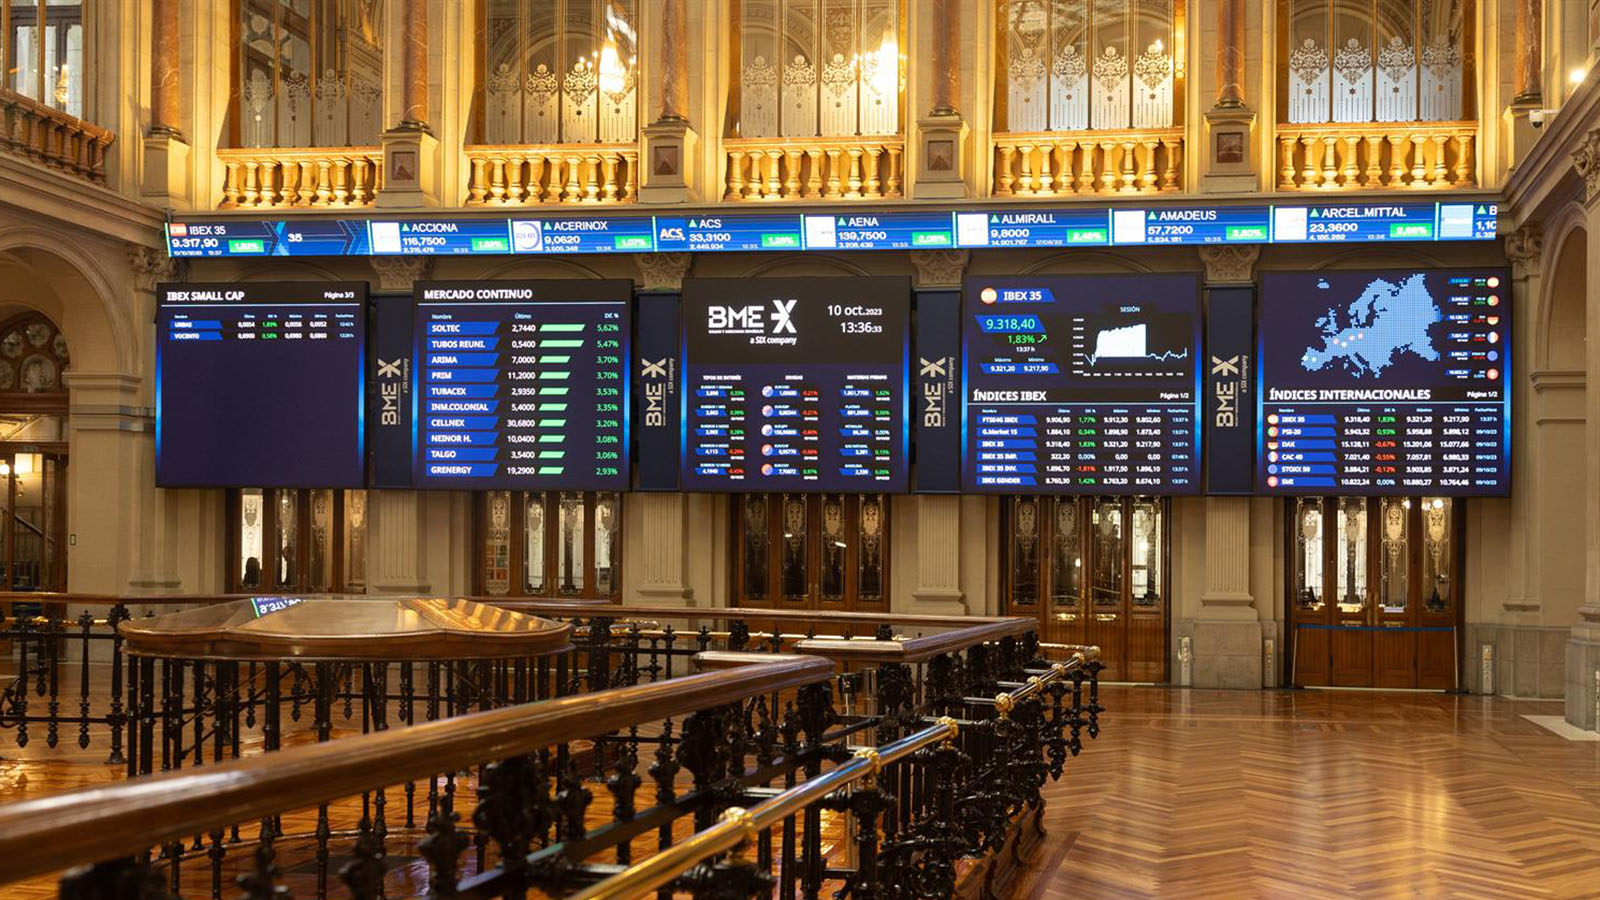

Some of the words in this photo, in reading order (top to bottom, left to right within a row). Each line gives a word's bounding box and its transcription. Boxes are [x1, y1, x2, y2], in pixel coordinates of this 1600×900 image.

[1159, 211, 1216, 220] AMADEUS
[1322, 208, 1406, 218] ARCEL.MITTAL
[848, 218, 878, 226] AENA
[1002, 214, 1056, 223] ALMIRALL
[412, 223, 457, 232] ACCIONA
[554, 221, 607, 230] ACERINOX
[700, 220, 721, 228] ACS
[1310, 224, 1358, 232] 23,3600
[215, 226, 225, 234] 35
[660, 229, 682, 240] ACS
[991, 229, 1029, 238] 9,8000
[1148, 226, 1193, 235] 57,7200
[288, 234, 302, 242] 35
[544, 235, 580, 244] 9,0620
[690, 233, 730, 242] 33,3100
[839, 232, 886, 241] 139,7500
[172, 238, 218, 249] 9.317,90
[403, 237, 446, 246] 116,7500
[167, 292, 189, 300] IBEX
[192, 292, 223, 300] SMALL
[424, 290, 473, 299] MERCADO
[476, 290, 533, 299] CONTINUO
[1004, 292, 1027, 300] IBEX
[1030, 292, 1041, 300] 35
[828, 305, 840, 315] 10
[845, 306, 882, 315] oct.2023
[709, 306, 764, 327] BME
[512, 325, 535, 333] 2,7440
[597, 324, 618, 332] 5,62%
[986, 319, 1035, 331] 9.318,40
[767, 337, 796, 345] company
[1008, 335, 1035, 344] 1,83%
[459, 340, 485, 348] REUNI.
[512, 341, 535, 349] 0,5400
[597, 340, 618, 348] 5,47%
[512, 356, 535, 364] 7,0000
[597, 356, 618, 364] 3,70%
[508, 372, 535, 380] 11,2000
[597, 372, 618, 380] 3,70%
[512, 388, 535, 396] 2,9350
[597, 388, 618, 396] 3,53%
[974, 389, 1018, 401] ÍNDICES
[1021, 391, 1046, 400] IBEX
[1270, 389, 1317, 400] ÍNDICES
[1319, 390, 1430, 400] INTERNACIONALES
[382, 383, 396, 424] BME
[512, 404, 535, 412] 5,4000
[597, 404, 618, 412] 3,35%
[646, 383, 661, 426] BME
[925, 383, 941, 426] BME
[1216, 382, 1233, 427] BME
[507, 420, 535, 428] 30,6800
[596, 420, 618, 428] 3,20%
[508, 435, 535, 443] 10,0400
[511, 451, 535, 459] 3,5400
[431, 466, 472, 474] GRENERGY
[507, 467, 535, 475] 19,2900
